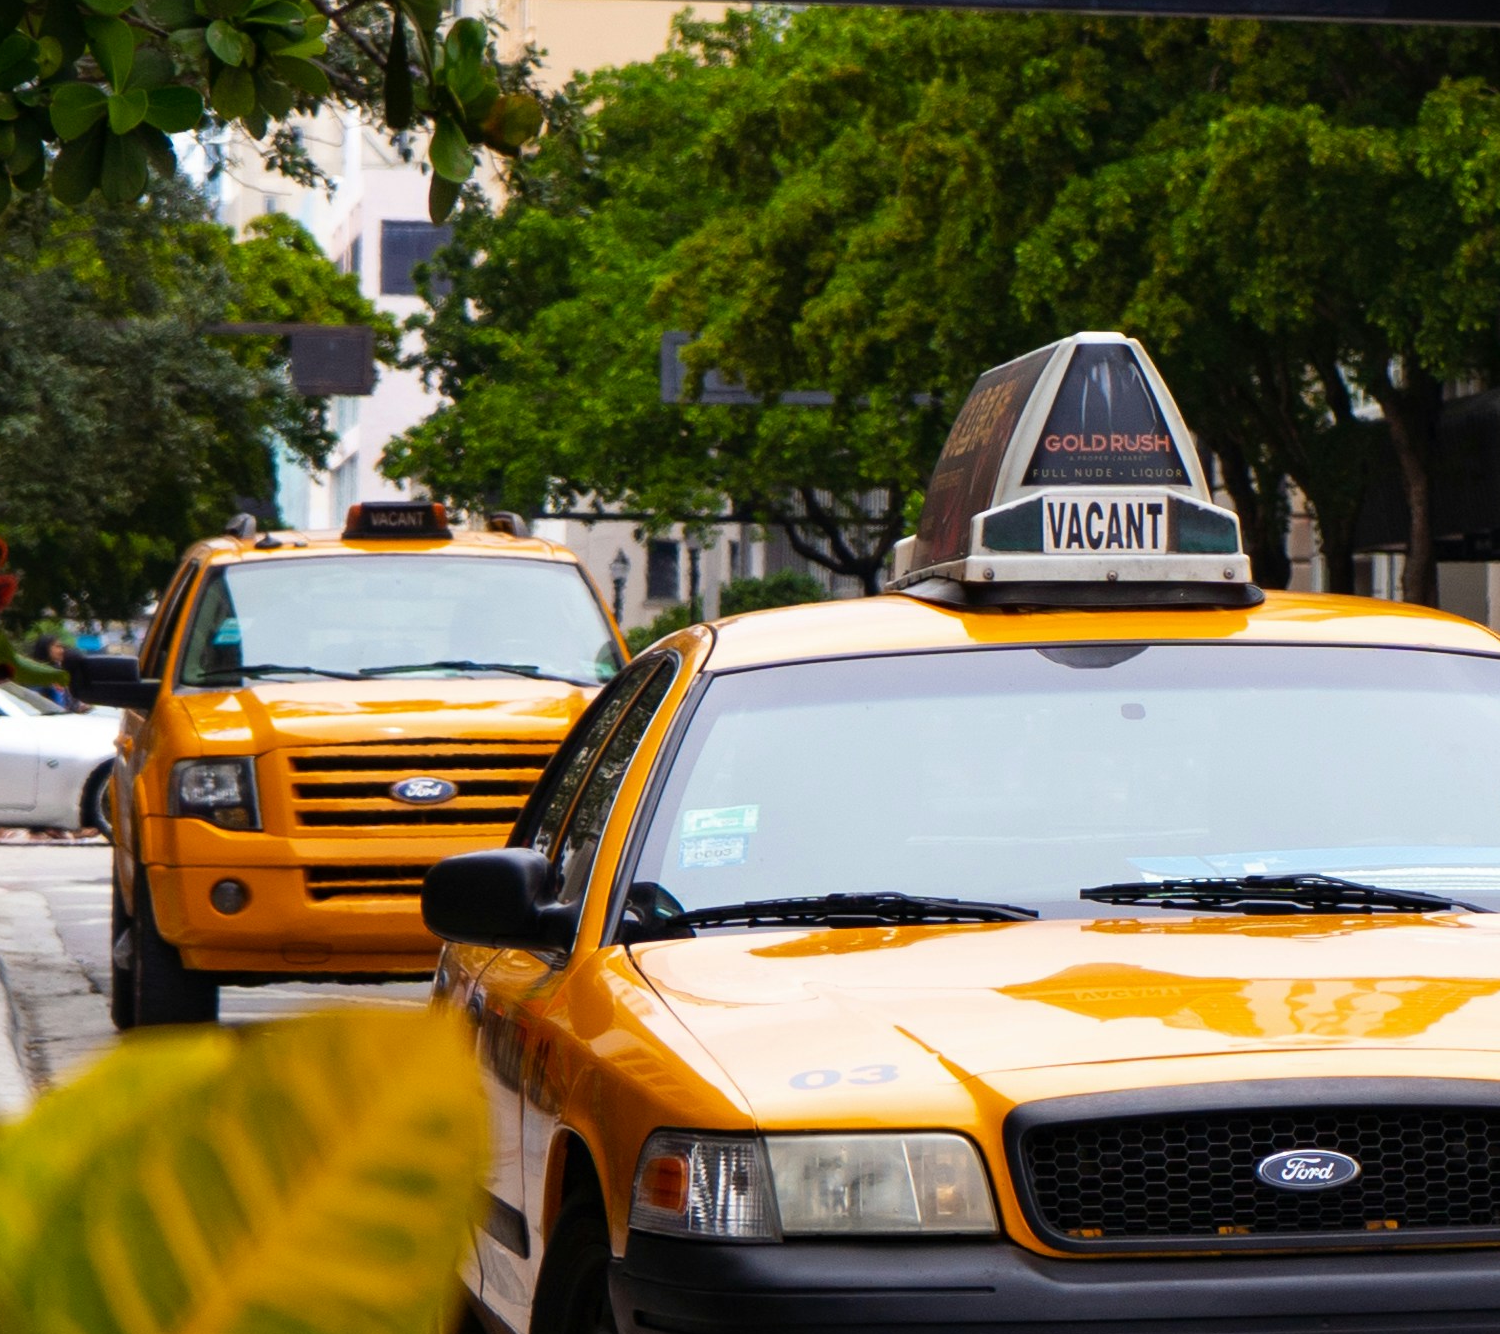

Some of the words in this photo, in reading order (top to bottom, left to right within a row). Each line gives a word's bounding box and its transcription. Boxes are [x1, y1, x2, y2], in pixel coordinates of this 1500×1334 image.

[1045, 435, 1107, 452] GOLD
[1110, 434, 1171, 452] RUSH
[1033, 469, 1067, 478] FULL
[1075, 469, 1113, 478] NUDE
[1132, 468, 1183, 477] LIQUOR
[371, 511, 426, 526] VACANT
[1047, 501, 1163, 550] VACANT
[405, 780, 443, 797] Ford
[788, 1064, 899, 1090] 03
[1281, 1157, 1335, 1180] Ford
